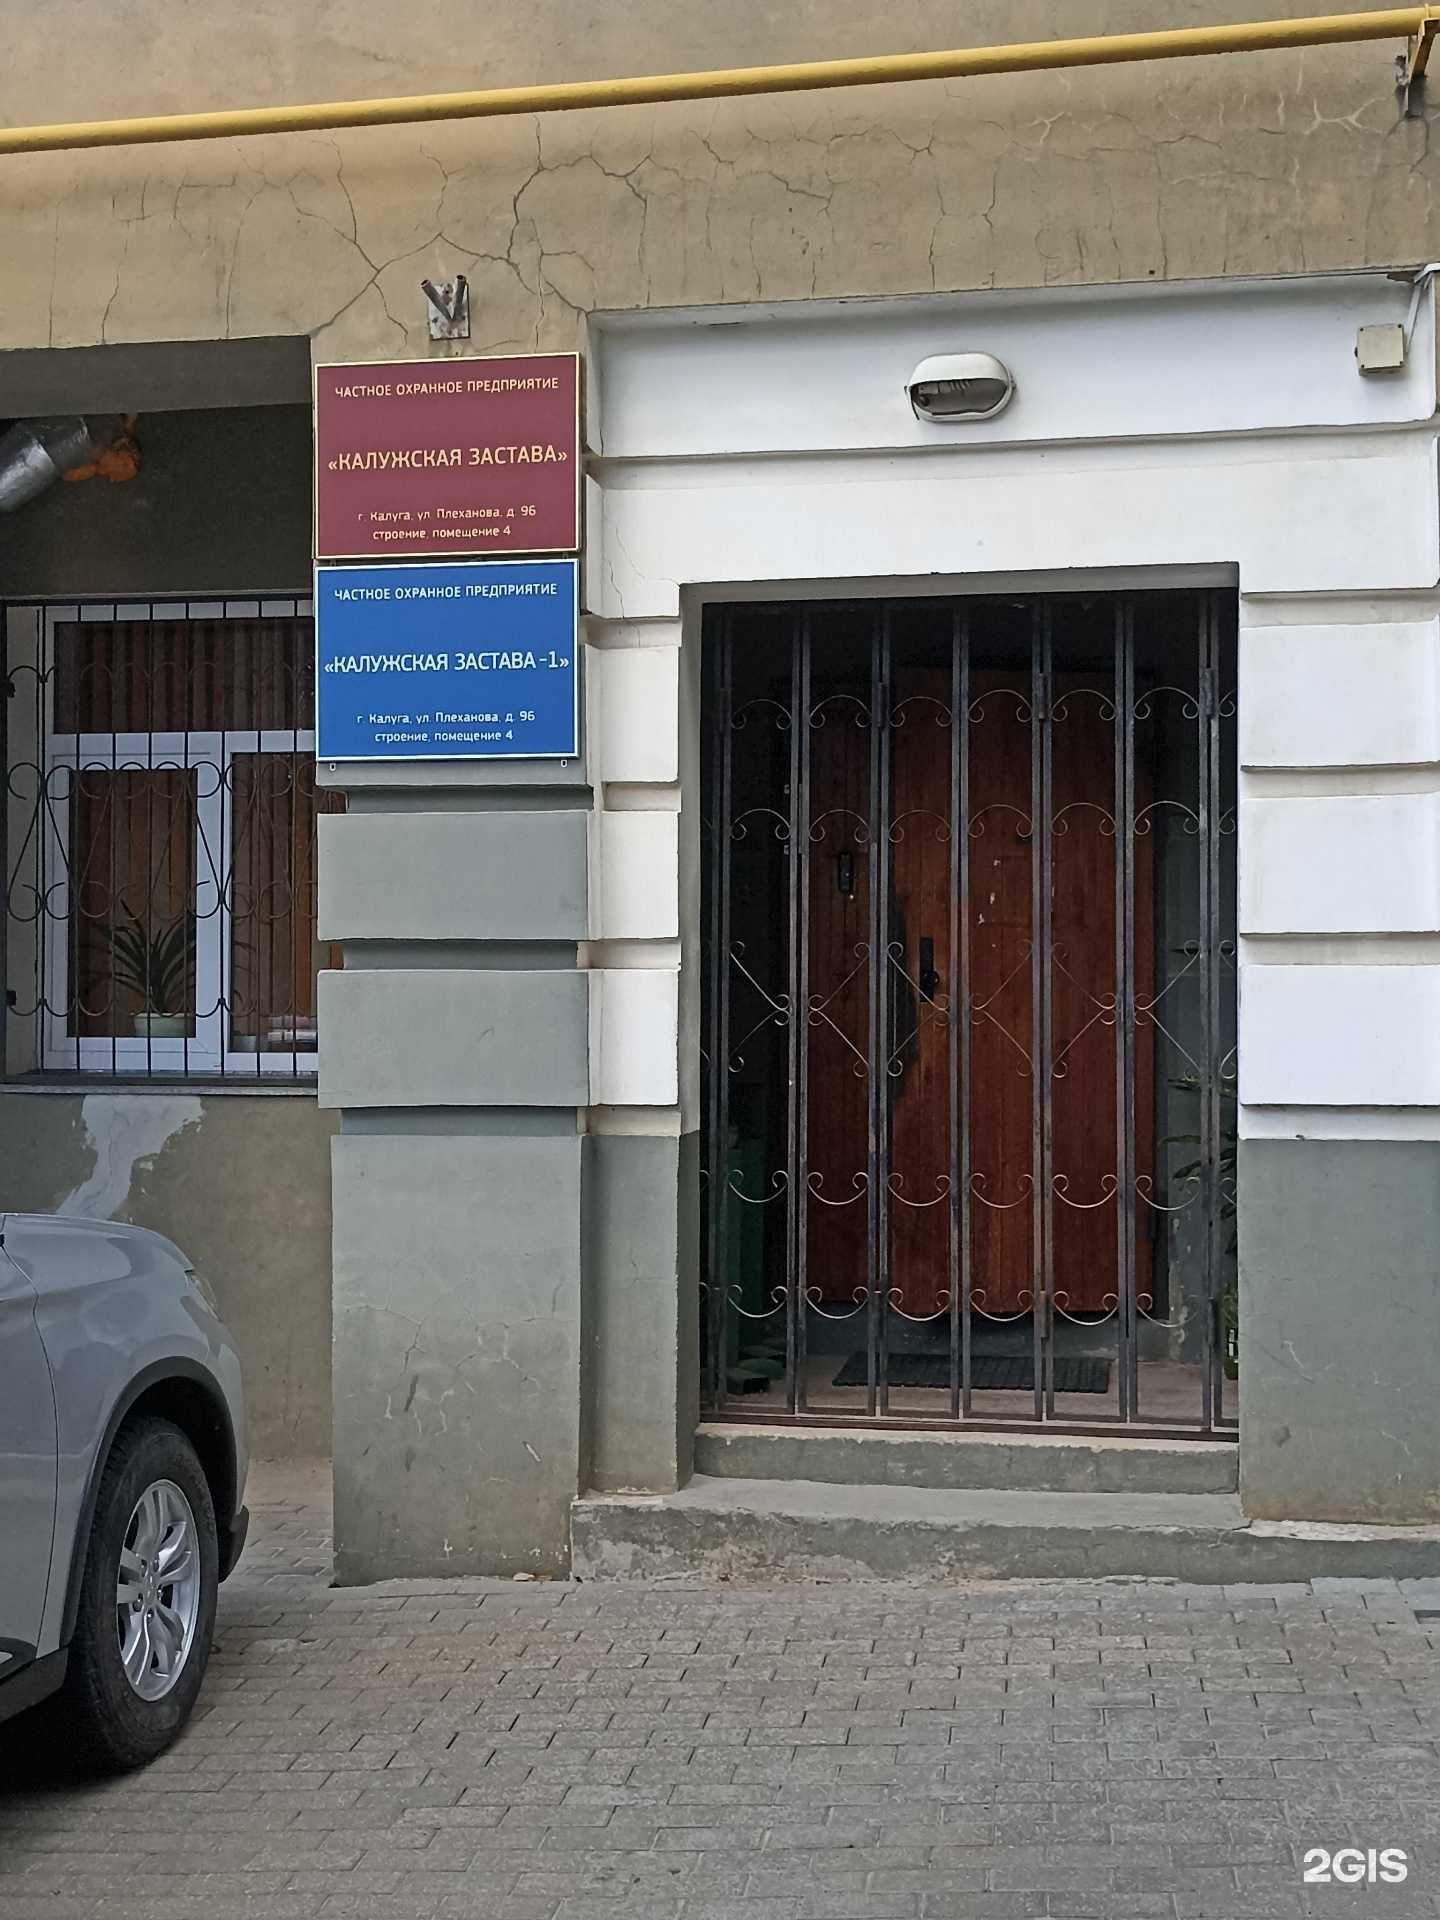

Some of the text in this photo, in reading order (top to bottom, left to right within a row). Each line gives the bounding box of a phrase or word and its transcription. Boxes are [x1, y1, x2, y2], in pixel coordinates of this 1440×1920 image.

[335, 376, 559, 398] ЧАСТНОЕ ОХРАННОЕ ПРЕДПРИЯТИЕ
[327, 444, 568, 471] «КАЛУЖСКАЯ ЗАСТАВА»
[520, 504, 537, 517] 96
[372, 525, 512, 542] строение, помещение 4
[334, 583, 558, 601] ЧАСТНОЕ ОХРАННОЕ ПРЕДПРИЯТИЕ
[324, 653, 449, 673] «КАЛУЖСКАЯ
[519, 709, 536, 722] 96
[374, 729, 514, 743] строение, помещение 4
